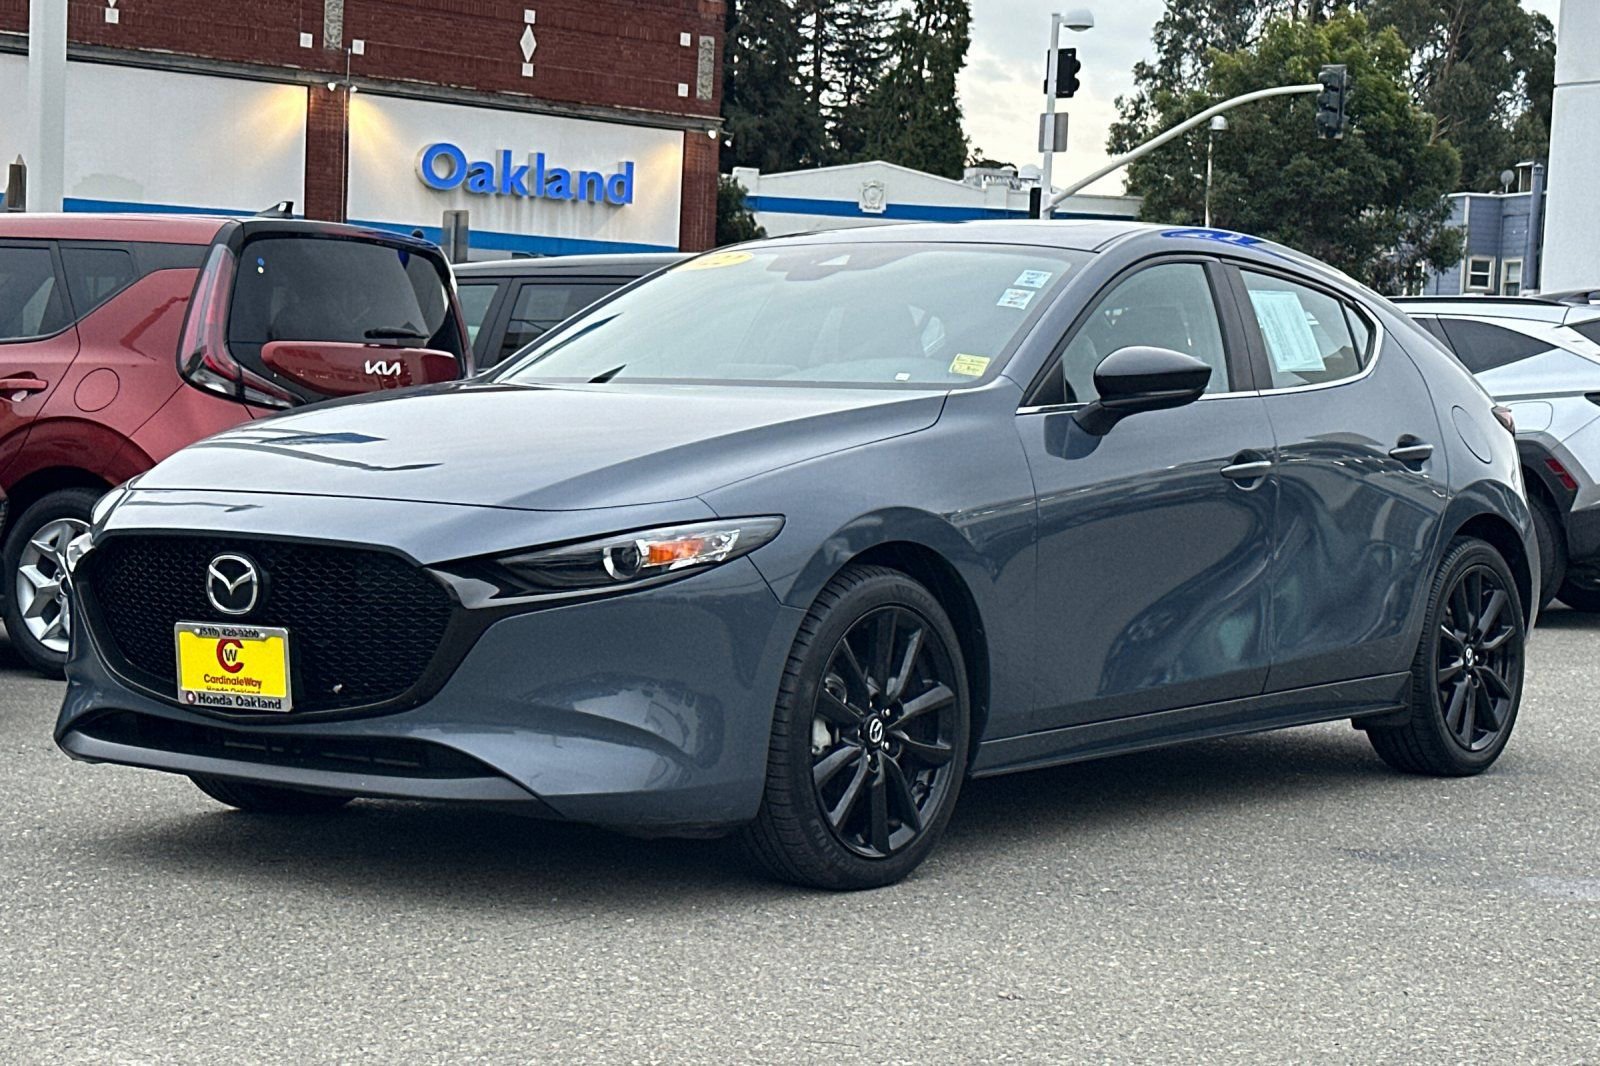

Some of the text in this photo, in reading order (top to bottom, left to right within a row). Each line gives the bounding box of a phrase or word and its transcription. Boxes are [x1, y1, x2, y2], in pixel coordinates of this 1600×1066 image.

[416, 142, 635, 205] Oakland
[365, 360, 401, 376] KIA
[199, 627, 220, 637] (510)
[203, 674, 262, 688] CardinaleWay
[198, 693, 281, 709] Honda Oakland
